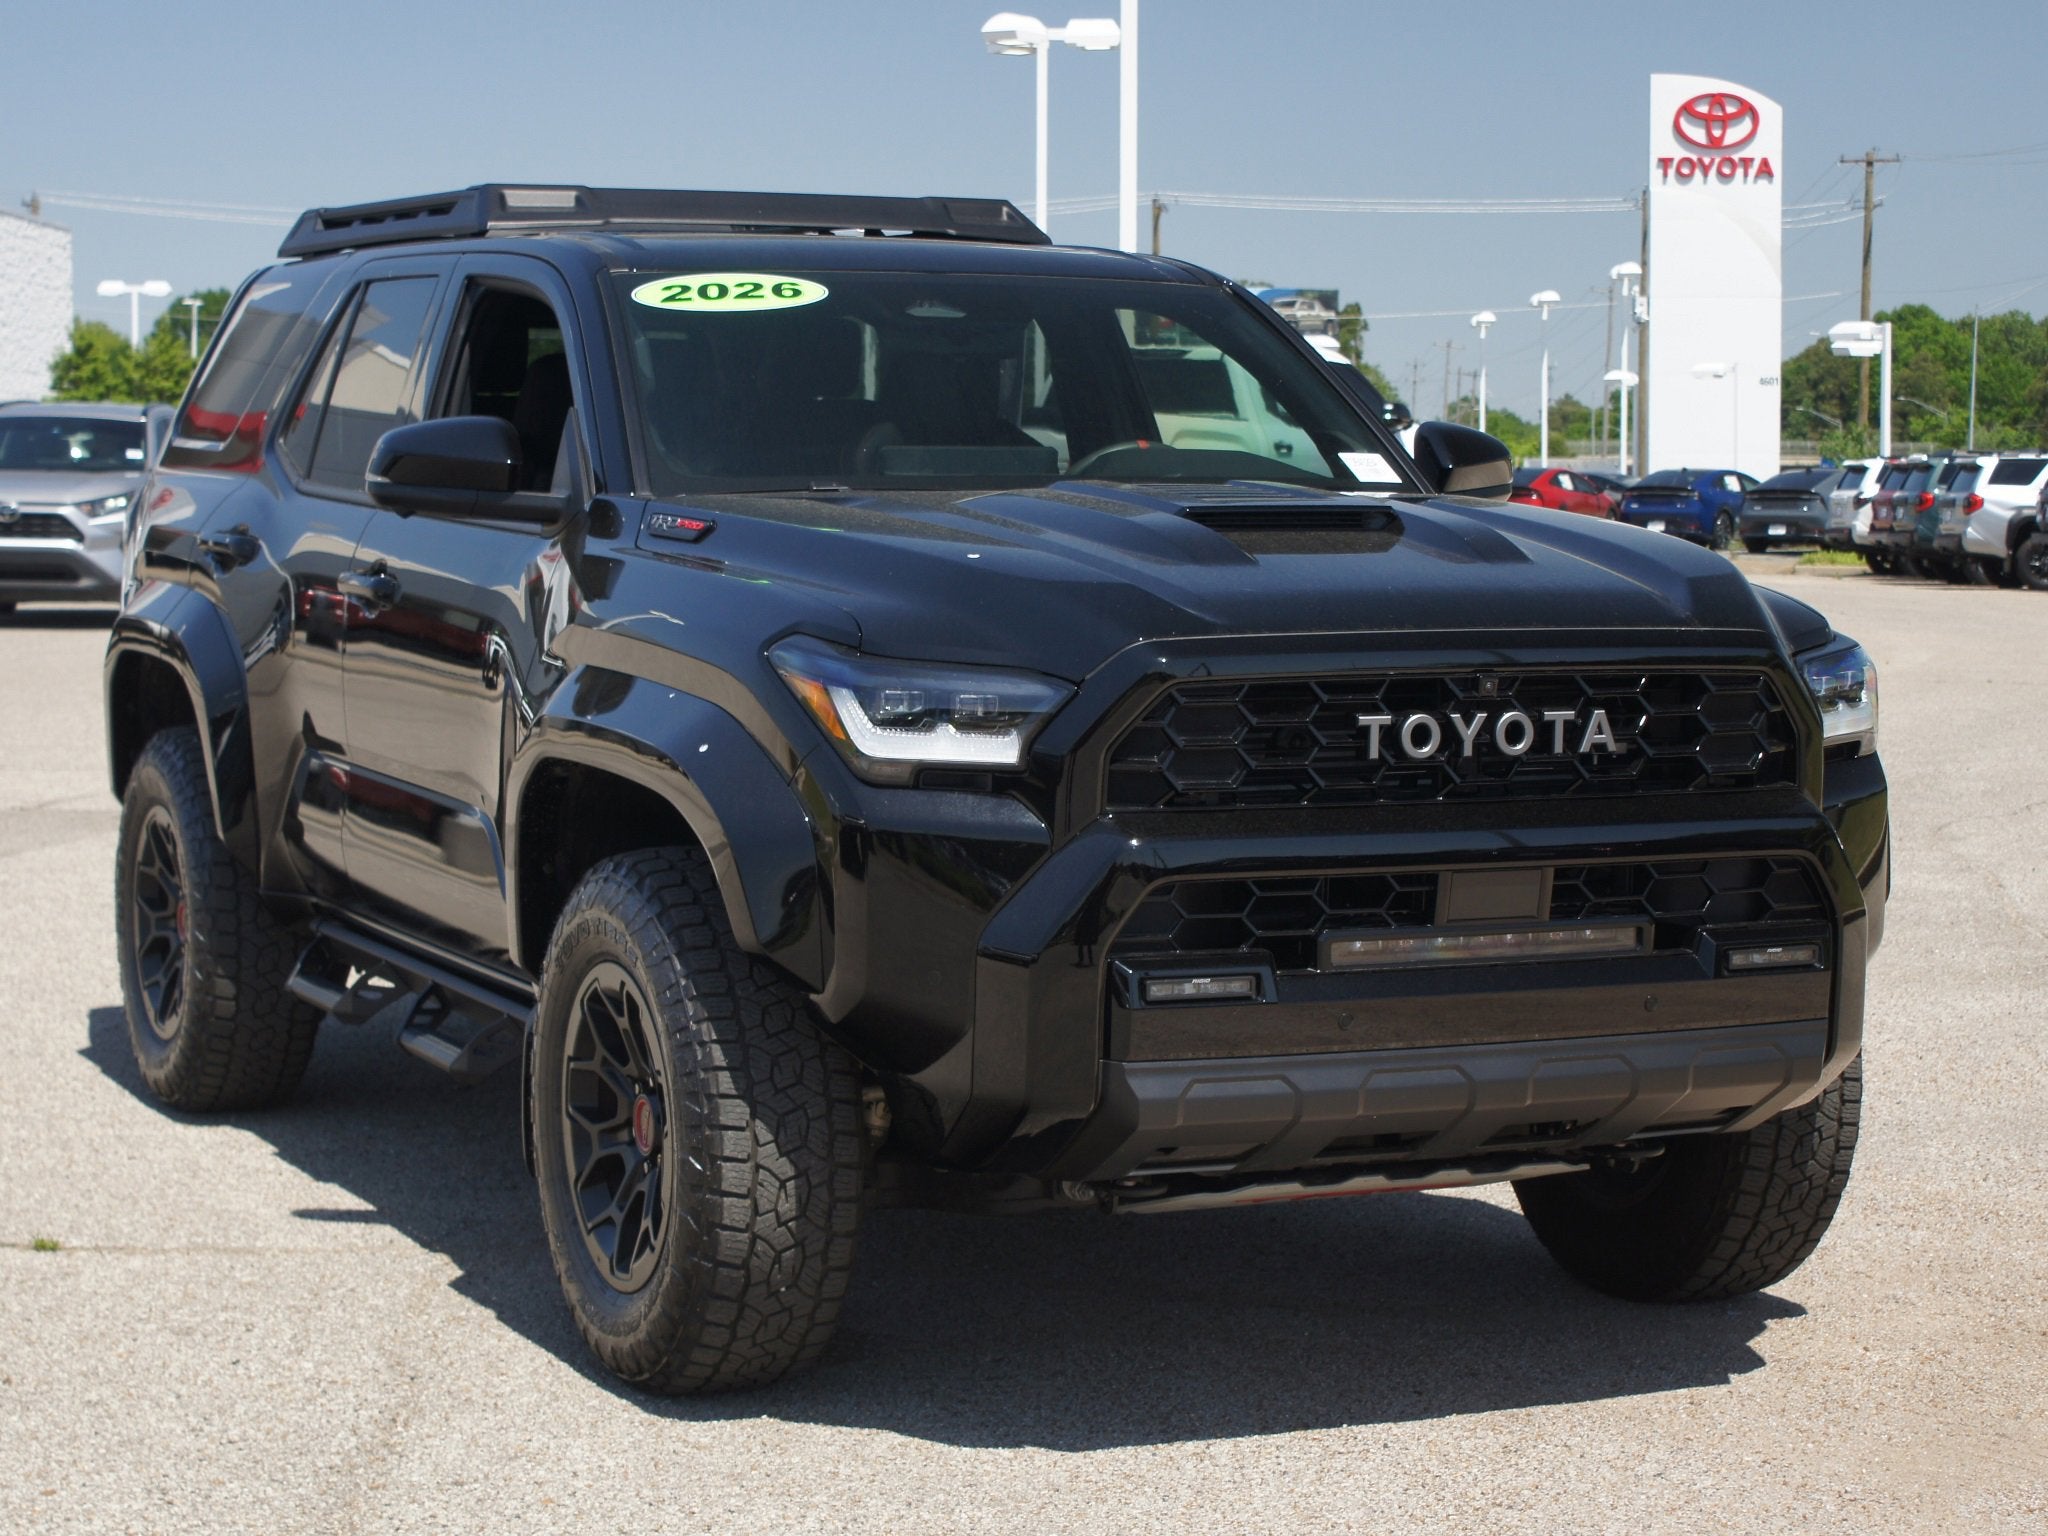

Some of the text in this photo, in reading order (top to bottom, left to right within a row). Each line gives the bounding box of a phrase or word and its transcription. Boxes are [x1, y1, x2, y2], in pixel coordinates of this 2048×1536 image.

[1657, 156, 1774, 179] TOYOTA
[660, 282, 802, 303] 2026
[1759, 376, 1779, 386] 4601
[675, 517, 705, 530] PRO
[1358, 710, 1617, 760] TOYOTA
